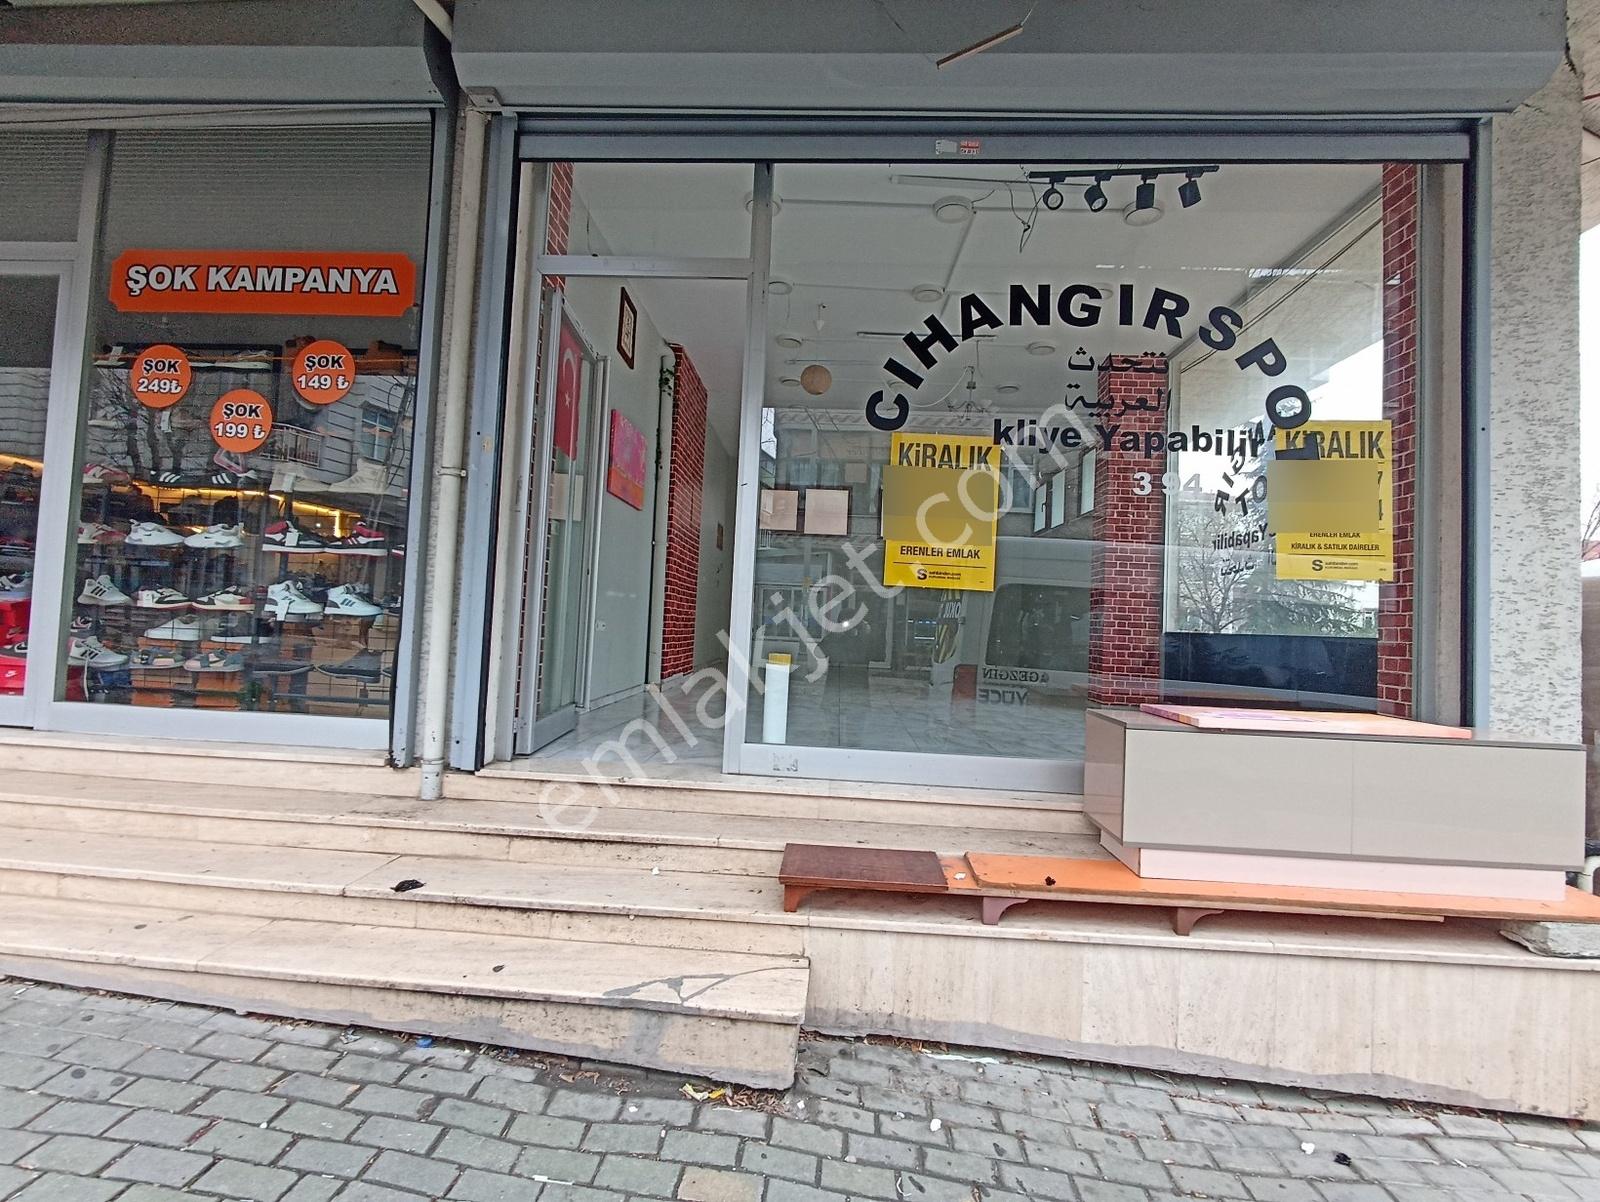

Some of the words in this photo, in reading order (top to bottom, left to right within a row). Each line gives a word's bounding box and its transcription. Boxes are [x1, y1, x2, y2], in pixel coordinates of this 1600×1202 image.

[127, 265, 199, 296] ŞOK
[207, 265, 399, 294] KAMPANYA
[143, 358, 182, 374] ŞOK
[305, 354, 345, 371] ŞOK
[297, 375, 332, 389] 149
[1065, 383, 1172, 418] العربية
[222, 403, 262, 419] ŞOK
[214, 423, 248, 438] 199
[994, 419, 1081, 453] kliye
[1095, 424, 1266, 458] Yapabilir
[1285, 430, 1385, 459] KRALIK
[900, 545, 943, 557] ERENLER
[947, 548, 980, 559] EMLAK
